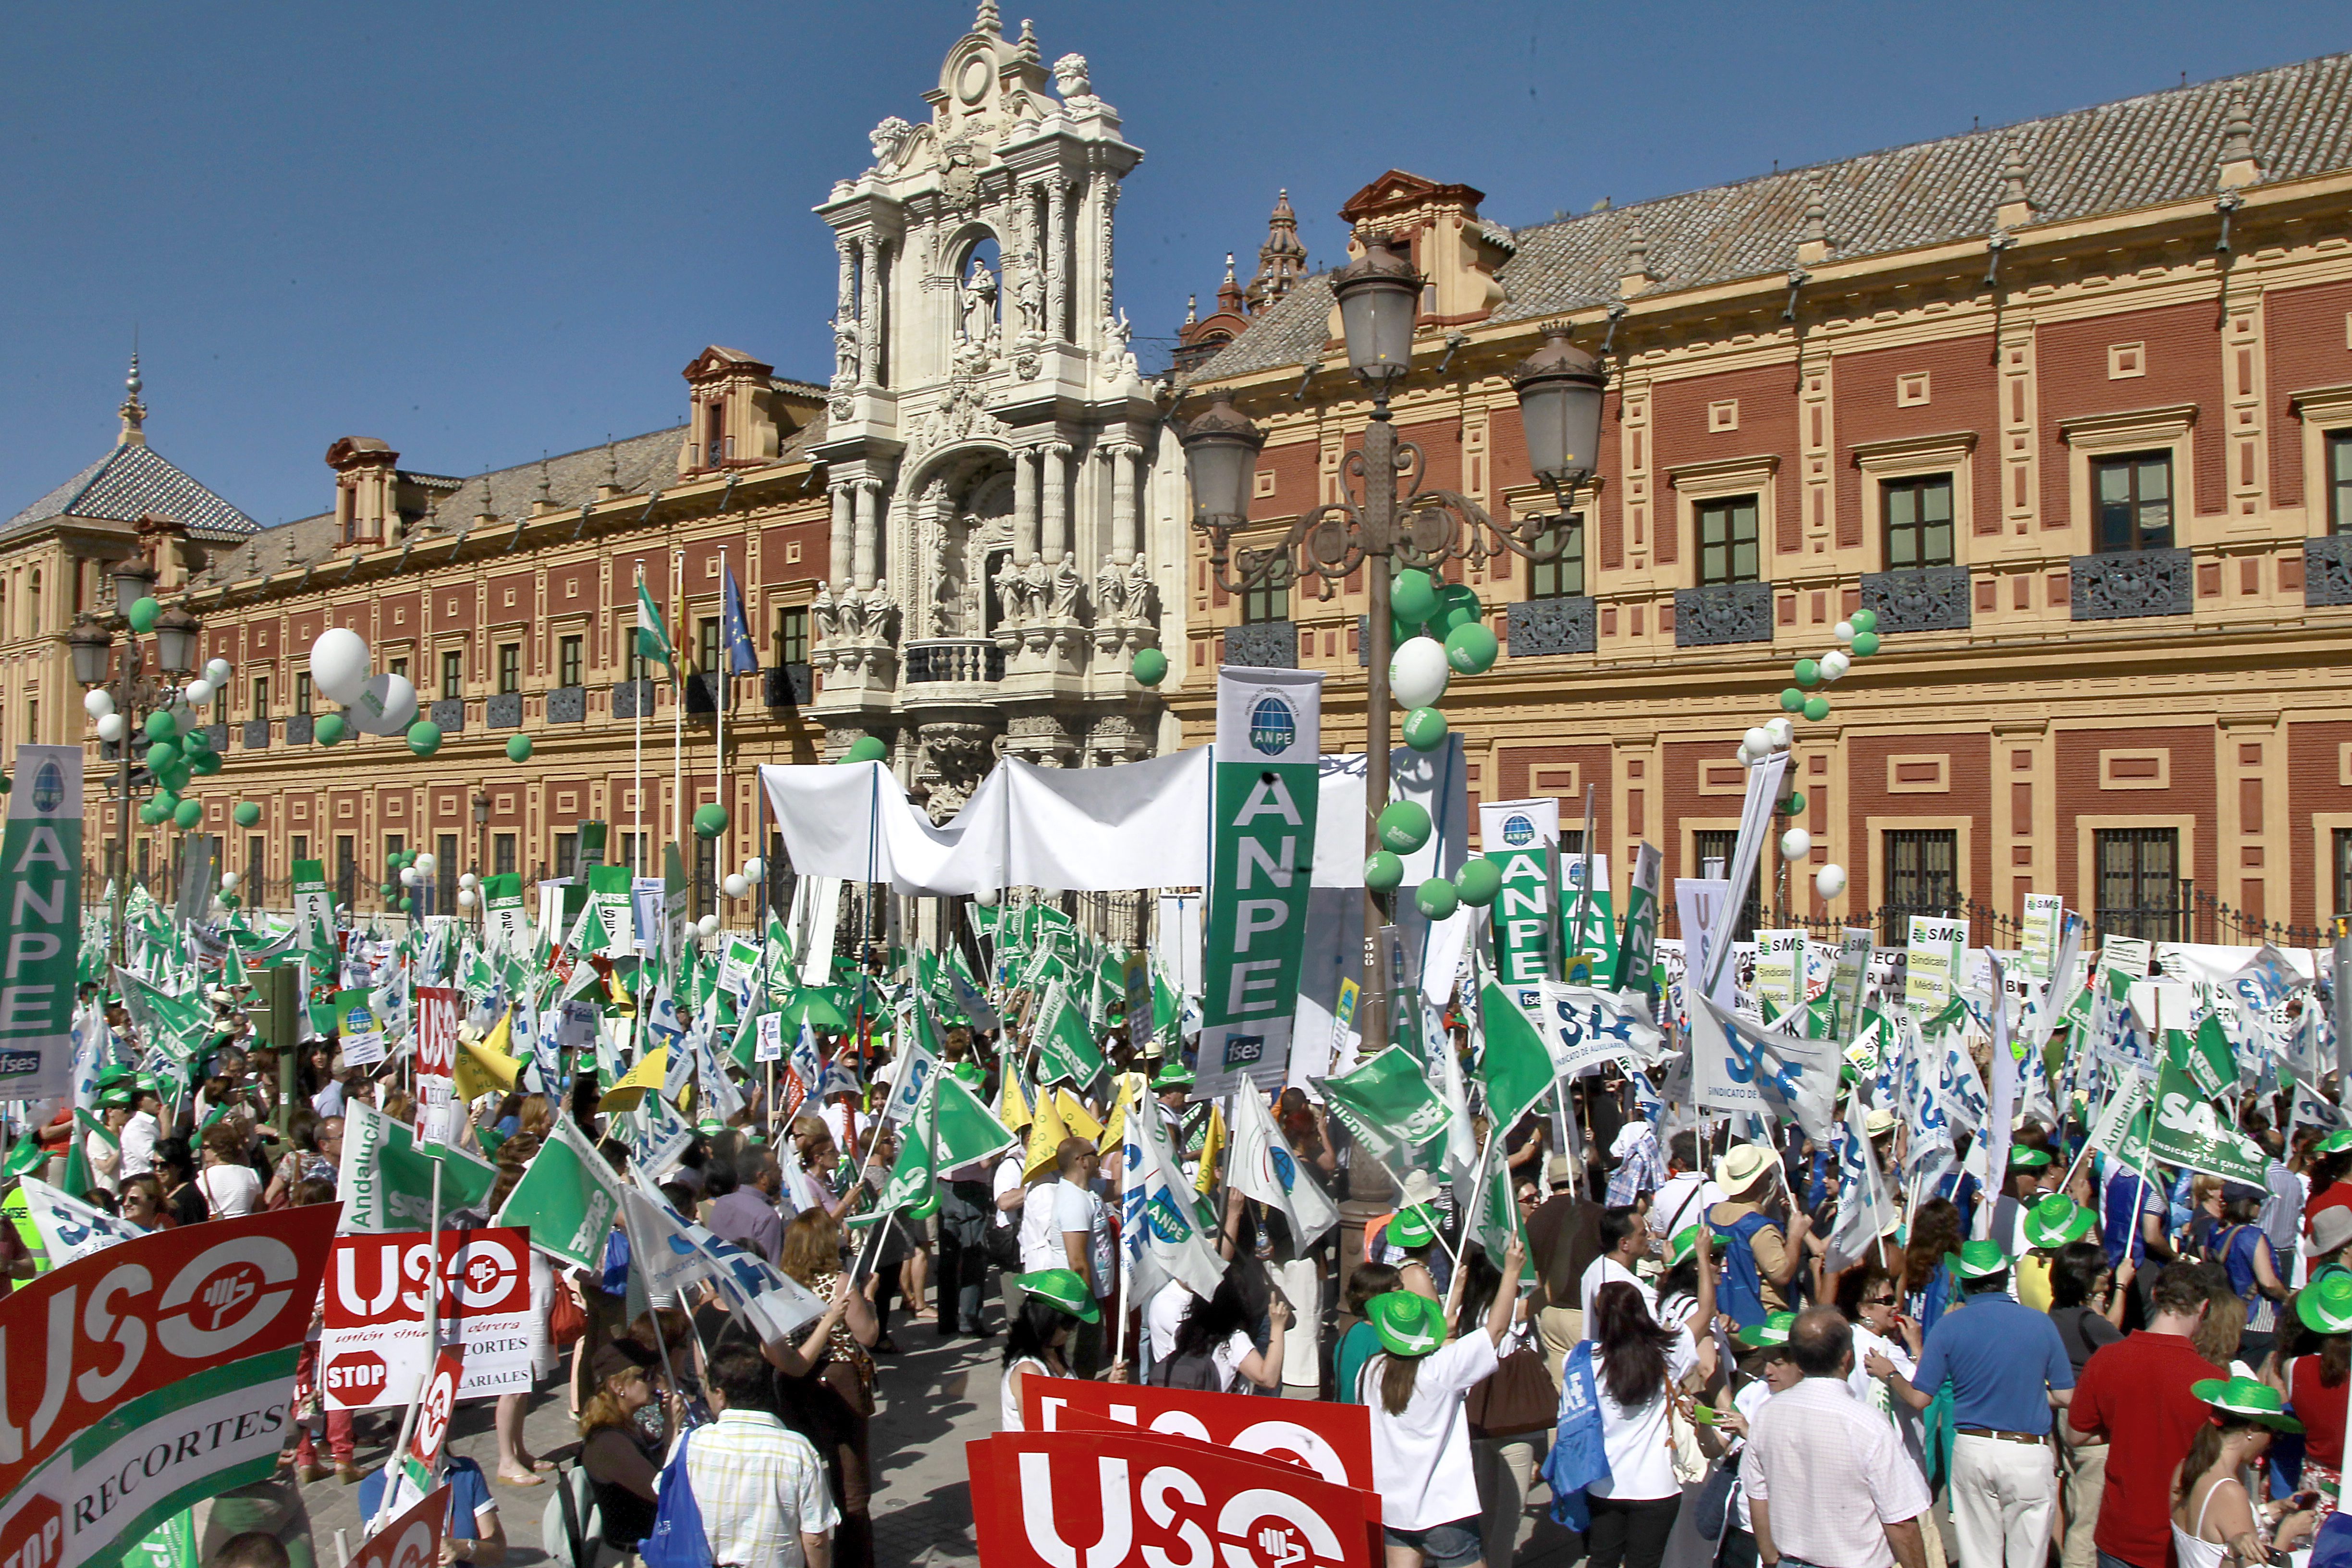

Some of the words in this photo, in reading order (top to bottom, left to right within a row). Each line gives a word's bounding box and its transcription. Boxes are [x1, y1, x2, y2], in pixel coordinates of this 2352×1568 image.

[1254, 731, 1292, 745] ANPE
[1506, 833, 1533, 841] ANPE
[488, 895, 522, 907] SATSE
[1226, 772, 1303, 1015] ANPE
[0, 826, 71, 1031] ANPE
[1501, 854, 1548, 980] ANPE
[1627, 899, 1655, 982] ANP
[1759, 968, 1792, 977] Sindicato
[1911, 955, 1948, 967] Sindicato
[1521, 994, 1541, 1007] fse
[1806, 983, 1826, 1001] STO
[1913, 980, 1943, 992] Médico
[419, 997, 457, 1070] USO
[1051, 1034, 1092, 1081] SATSE
[1228, 1041, 1261, 1062] fses
[1708, 1086, 1745, 1099] SINDICATO
[1746, 1088, 1758, 1100] DE
[350, 1111, 382, 1228] Andalucía
[2203, 1155, 2217, 1165] DE
[2220, 1159, 2262, 1177] ENFER
[1148, 1204, 1185, 1241] ANPE
[337, 1240, 517, 1317] USO
[335, 1330, 384, 1344] unión
[467, 1320, 520, 1334] obrera
[0, 1236, 299, 1465] USO
[327, 1363, 385, 1388] STOP
[462, 1336, 528, 1357] CORTES
[460, 1369, 528, 1389] LARIALES
[3, 1515, 60, 1568] TOP
[73, 1402, 284, 1537] RECORTES
[1018, 1452, 1345, 1568] USO
